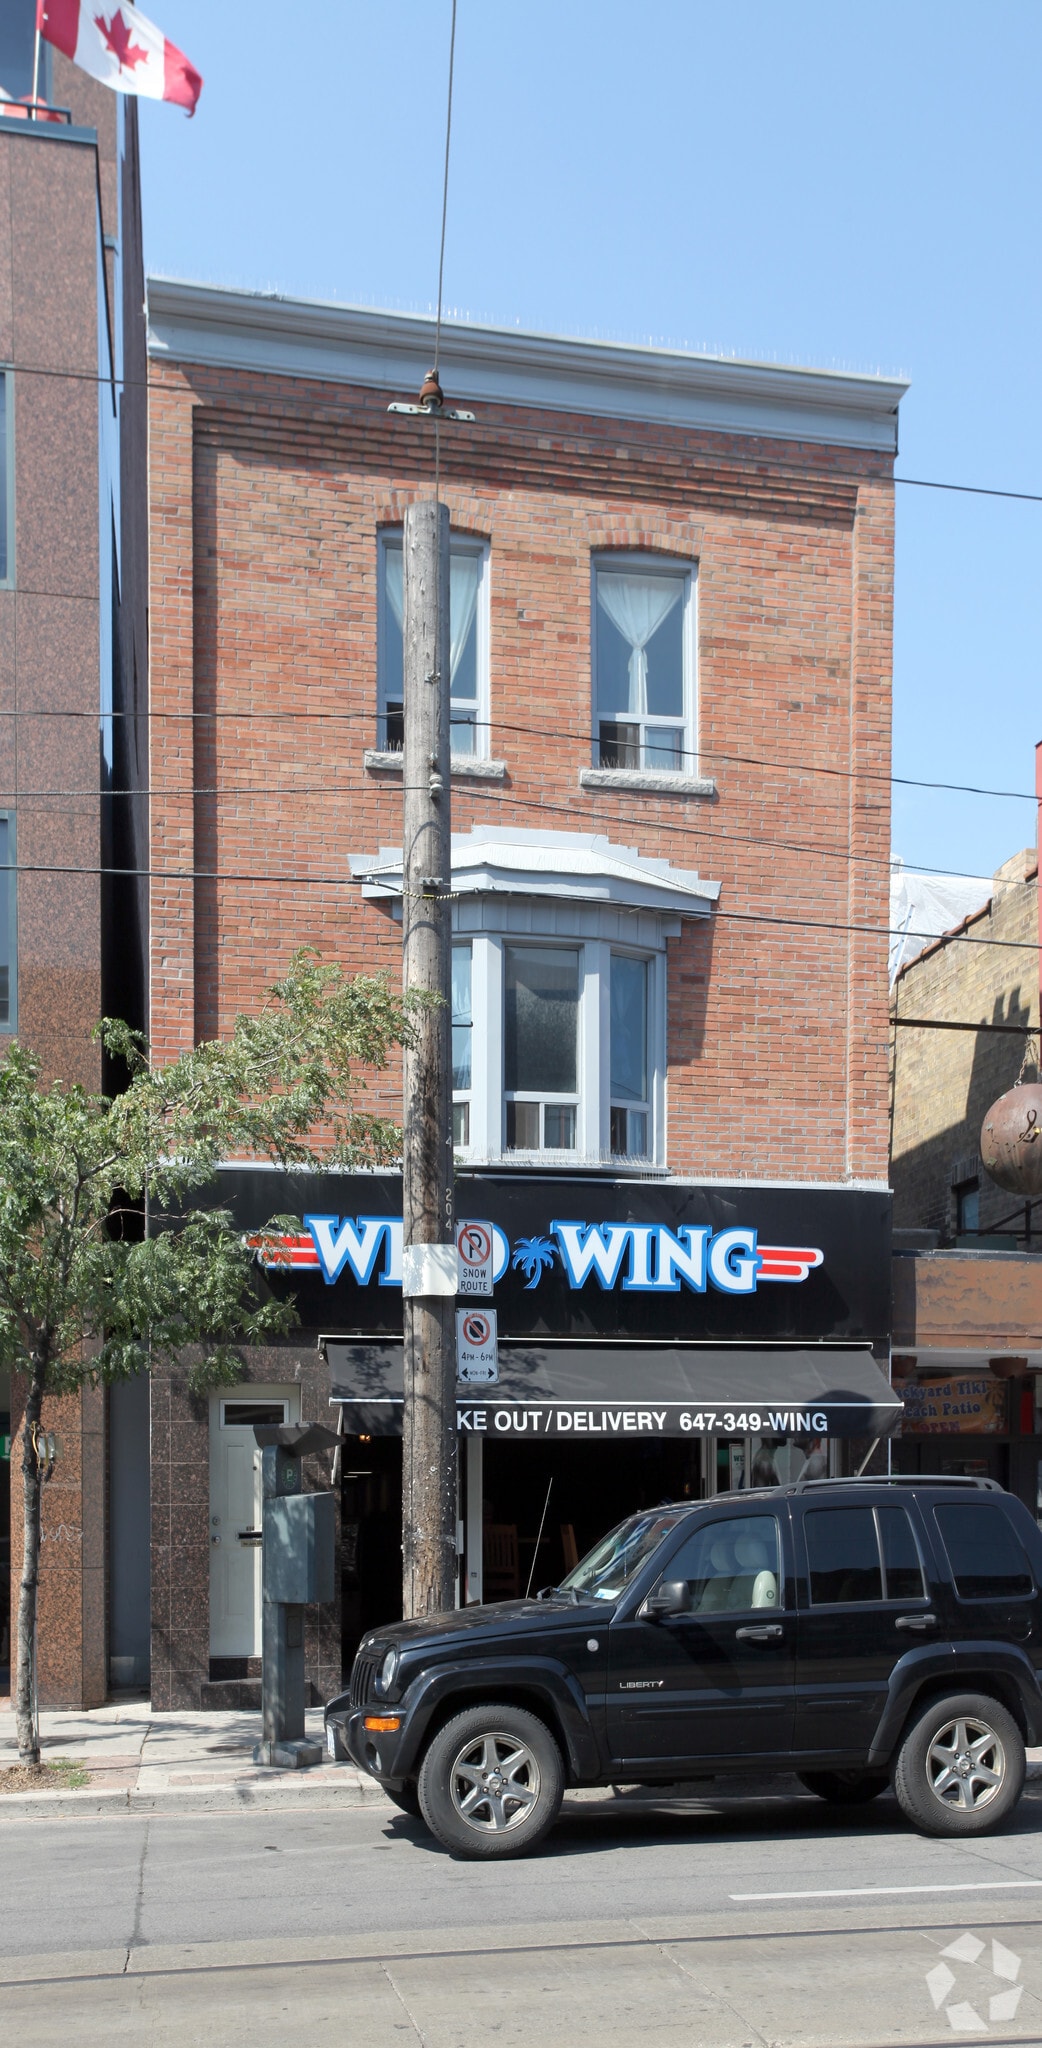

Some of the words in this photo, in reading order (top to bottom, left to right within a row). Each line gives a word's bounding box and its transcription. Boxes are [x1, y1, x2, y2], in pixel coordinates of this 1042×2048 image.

[303, 1213, 509, 1286] WI
[550, 1220, 763, 1294] WING
[463, 1268, 487, 1278] SNOW
[460, 1280, 488, 1291] ROUTE
[895, 1383, 952, 1400] ackyard
[956, 1380, 987, 1396] Tiki
[900, 1404, 938, 1418] each
[942, 1402, 981, 1416] Patio
[456, 1410, 487, 1431] KE
[679, 1412, 828, 1432] 647-349-WING
[619, 1680, 664, 1689] LIBERTY
